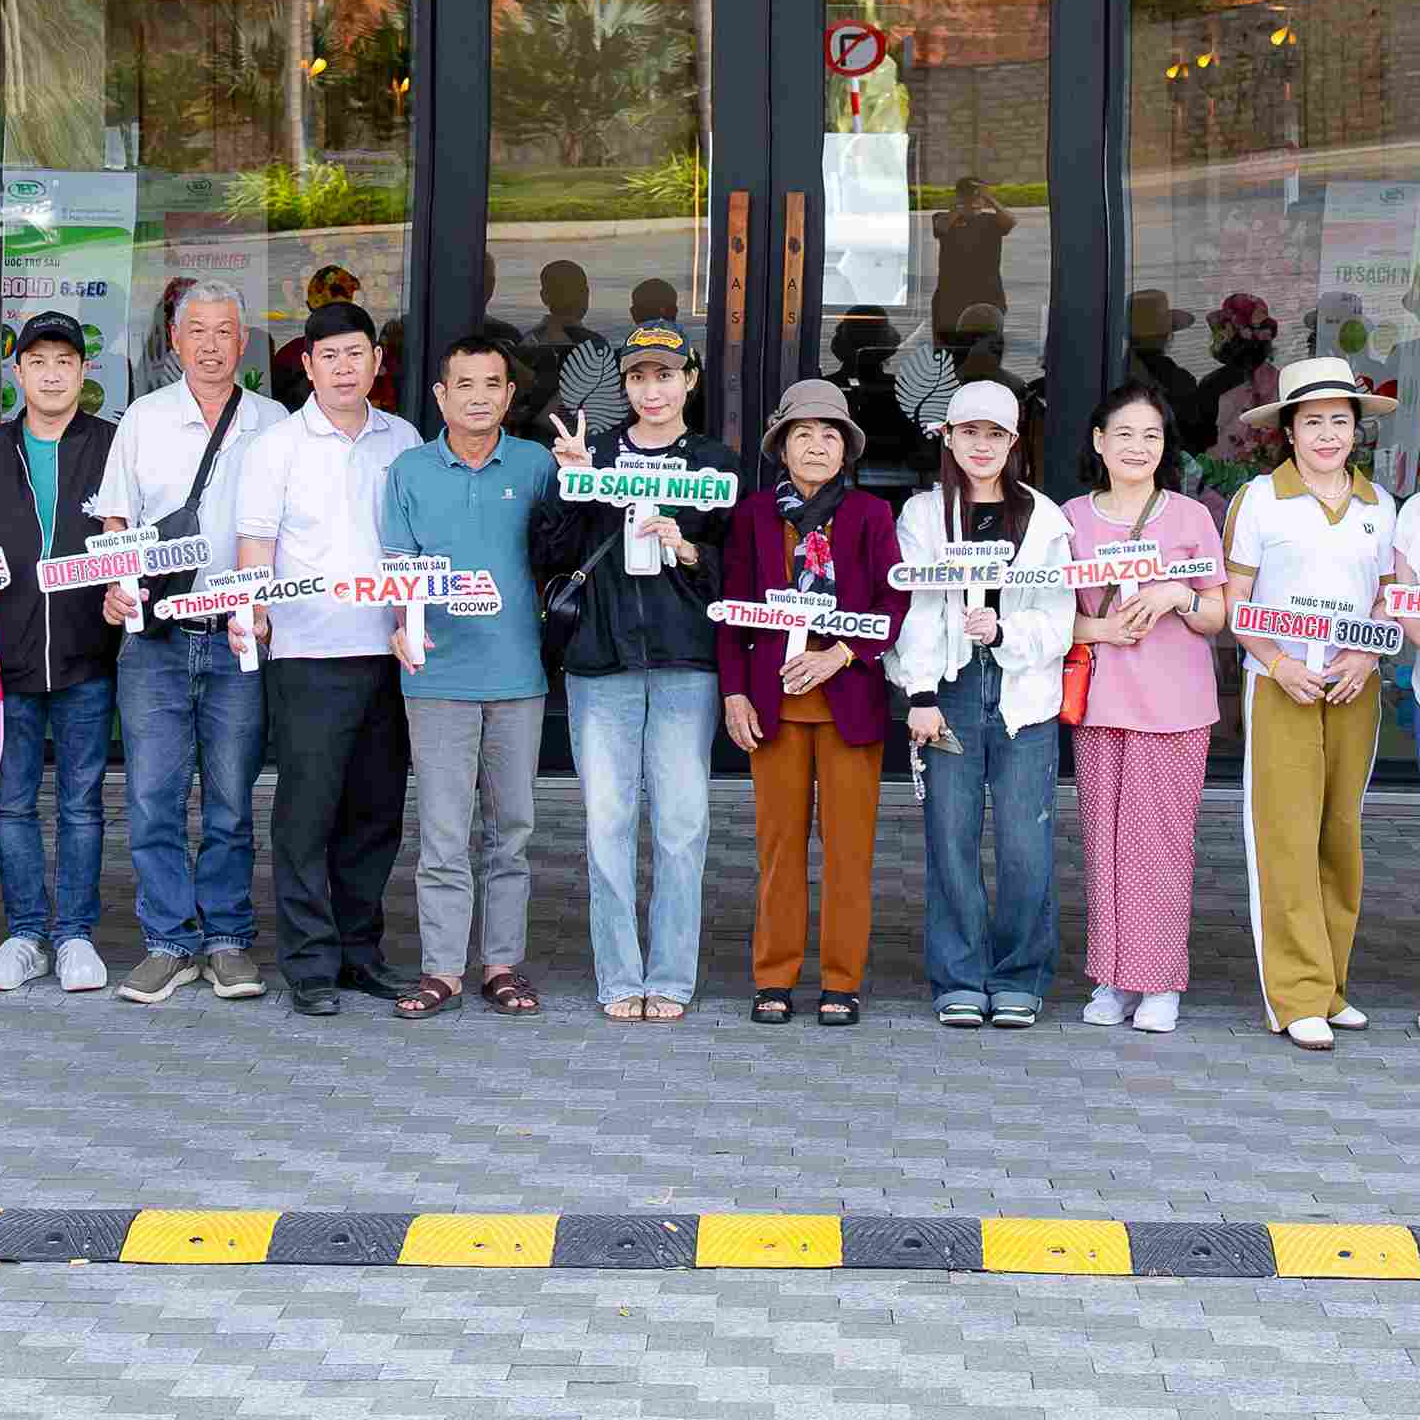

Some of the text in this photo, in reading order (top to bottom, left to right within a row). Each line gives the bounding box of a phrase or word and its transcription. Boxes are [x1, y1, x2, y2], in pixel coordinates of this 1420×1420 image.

[564, 472, 731, 504] TB SẠCH NHỆN
[43, 537, 211, 588] DIETSACH 300SC
[892, 560, 967, 583] CHIẾN
[1004, 568, 1060, 585] 300SC
[1062, 557, 1167, 586] THIAZOL
[171, 576, 326, 617] Thibifos 440EC
[355, 574, 497, 602] RAY USA
[449, 601, 499, 614] 400WP
[726, 603, 886, 636] Thibifos 440EC
[1237, 606, 1399, 649] DIETSACH 300SC
